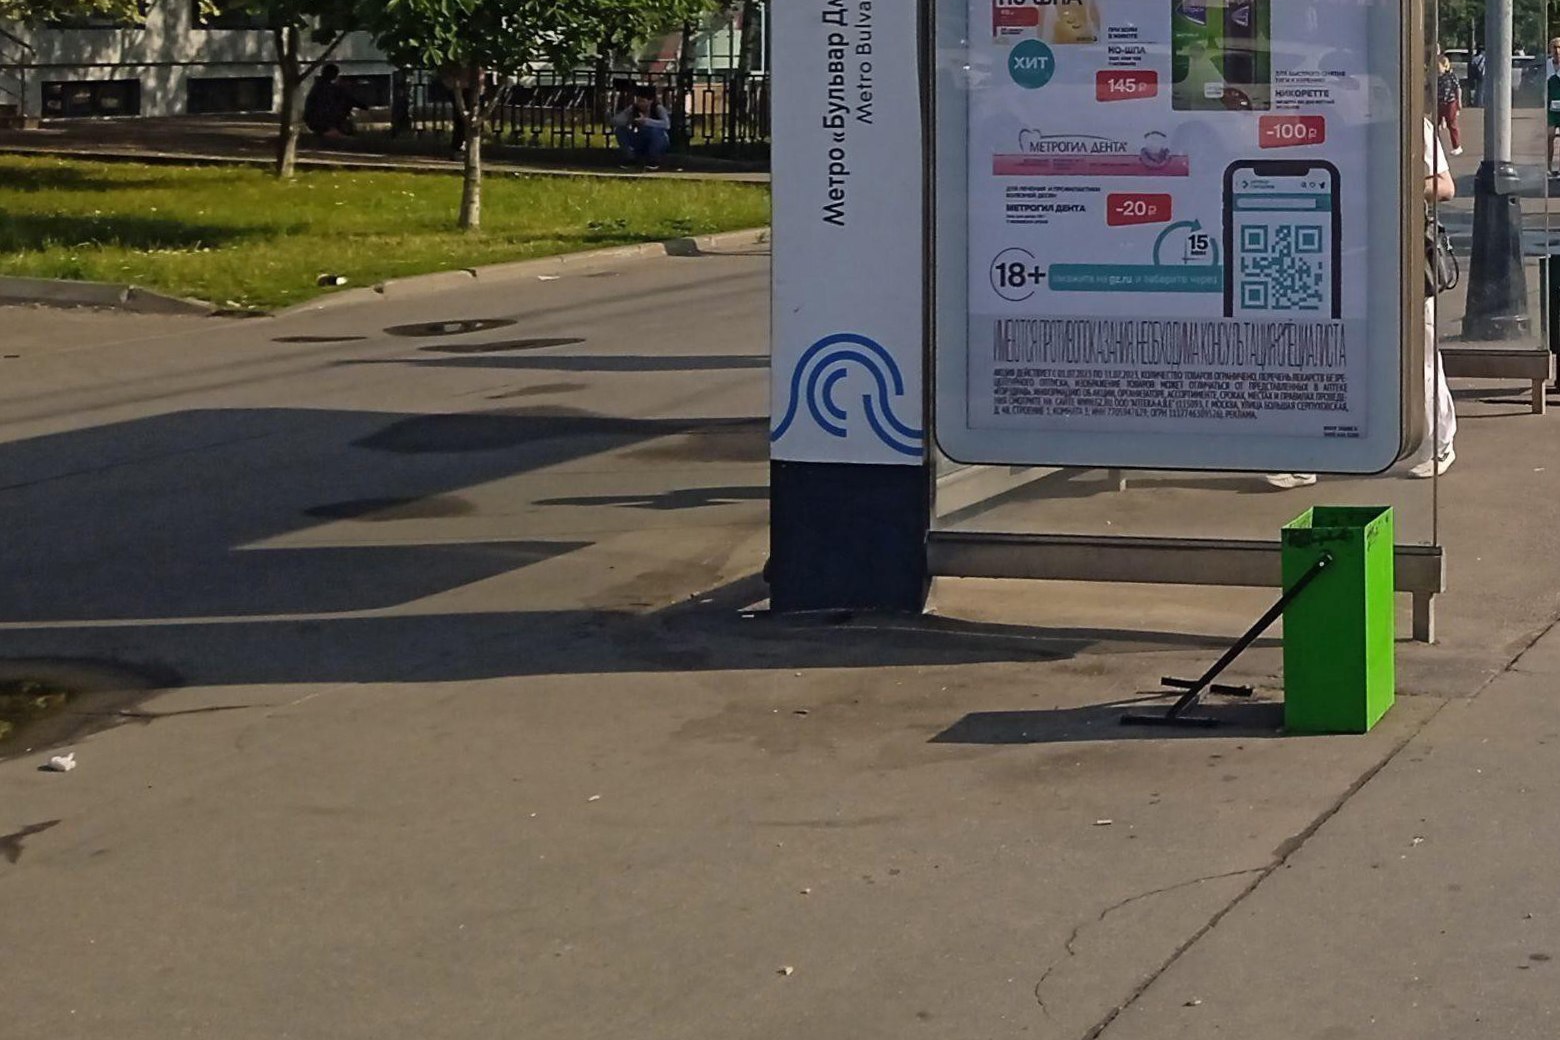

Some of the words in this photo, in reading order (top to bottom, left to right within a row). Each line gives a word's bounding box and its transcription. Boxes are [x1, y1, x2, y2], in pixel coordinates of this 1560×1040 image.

[1108, 46, 1147, 54] НО-ШПА
[1013, 56, 1048, 69] ХИТ
[823, 32, 850, 143] «Бульвар
[1108, 78, 1136, 93] 145
[856, 63, 873, 124] Metro
[1275, 89, 1329, 97] НИКОРЕТТЕ
[1030, 141, 1088, 153] МЕТРОГИЛ
[823, 147, 850, 226] Метро
[1006, 204, 1054, 212] МЕТРОГИЛ
[1055, 204, 1086, 213] ДЕНТА
[1188, 234, 1209, 250] 15
[995, 262, 1046, 288] 18+
[1109, 274, 1132, 285] gz.ru
